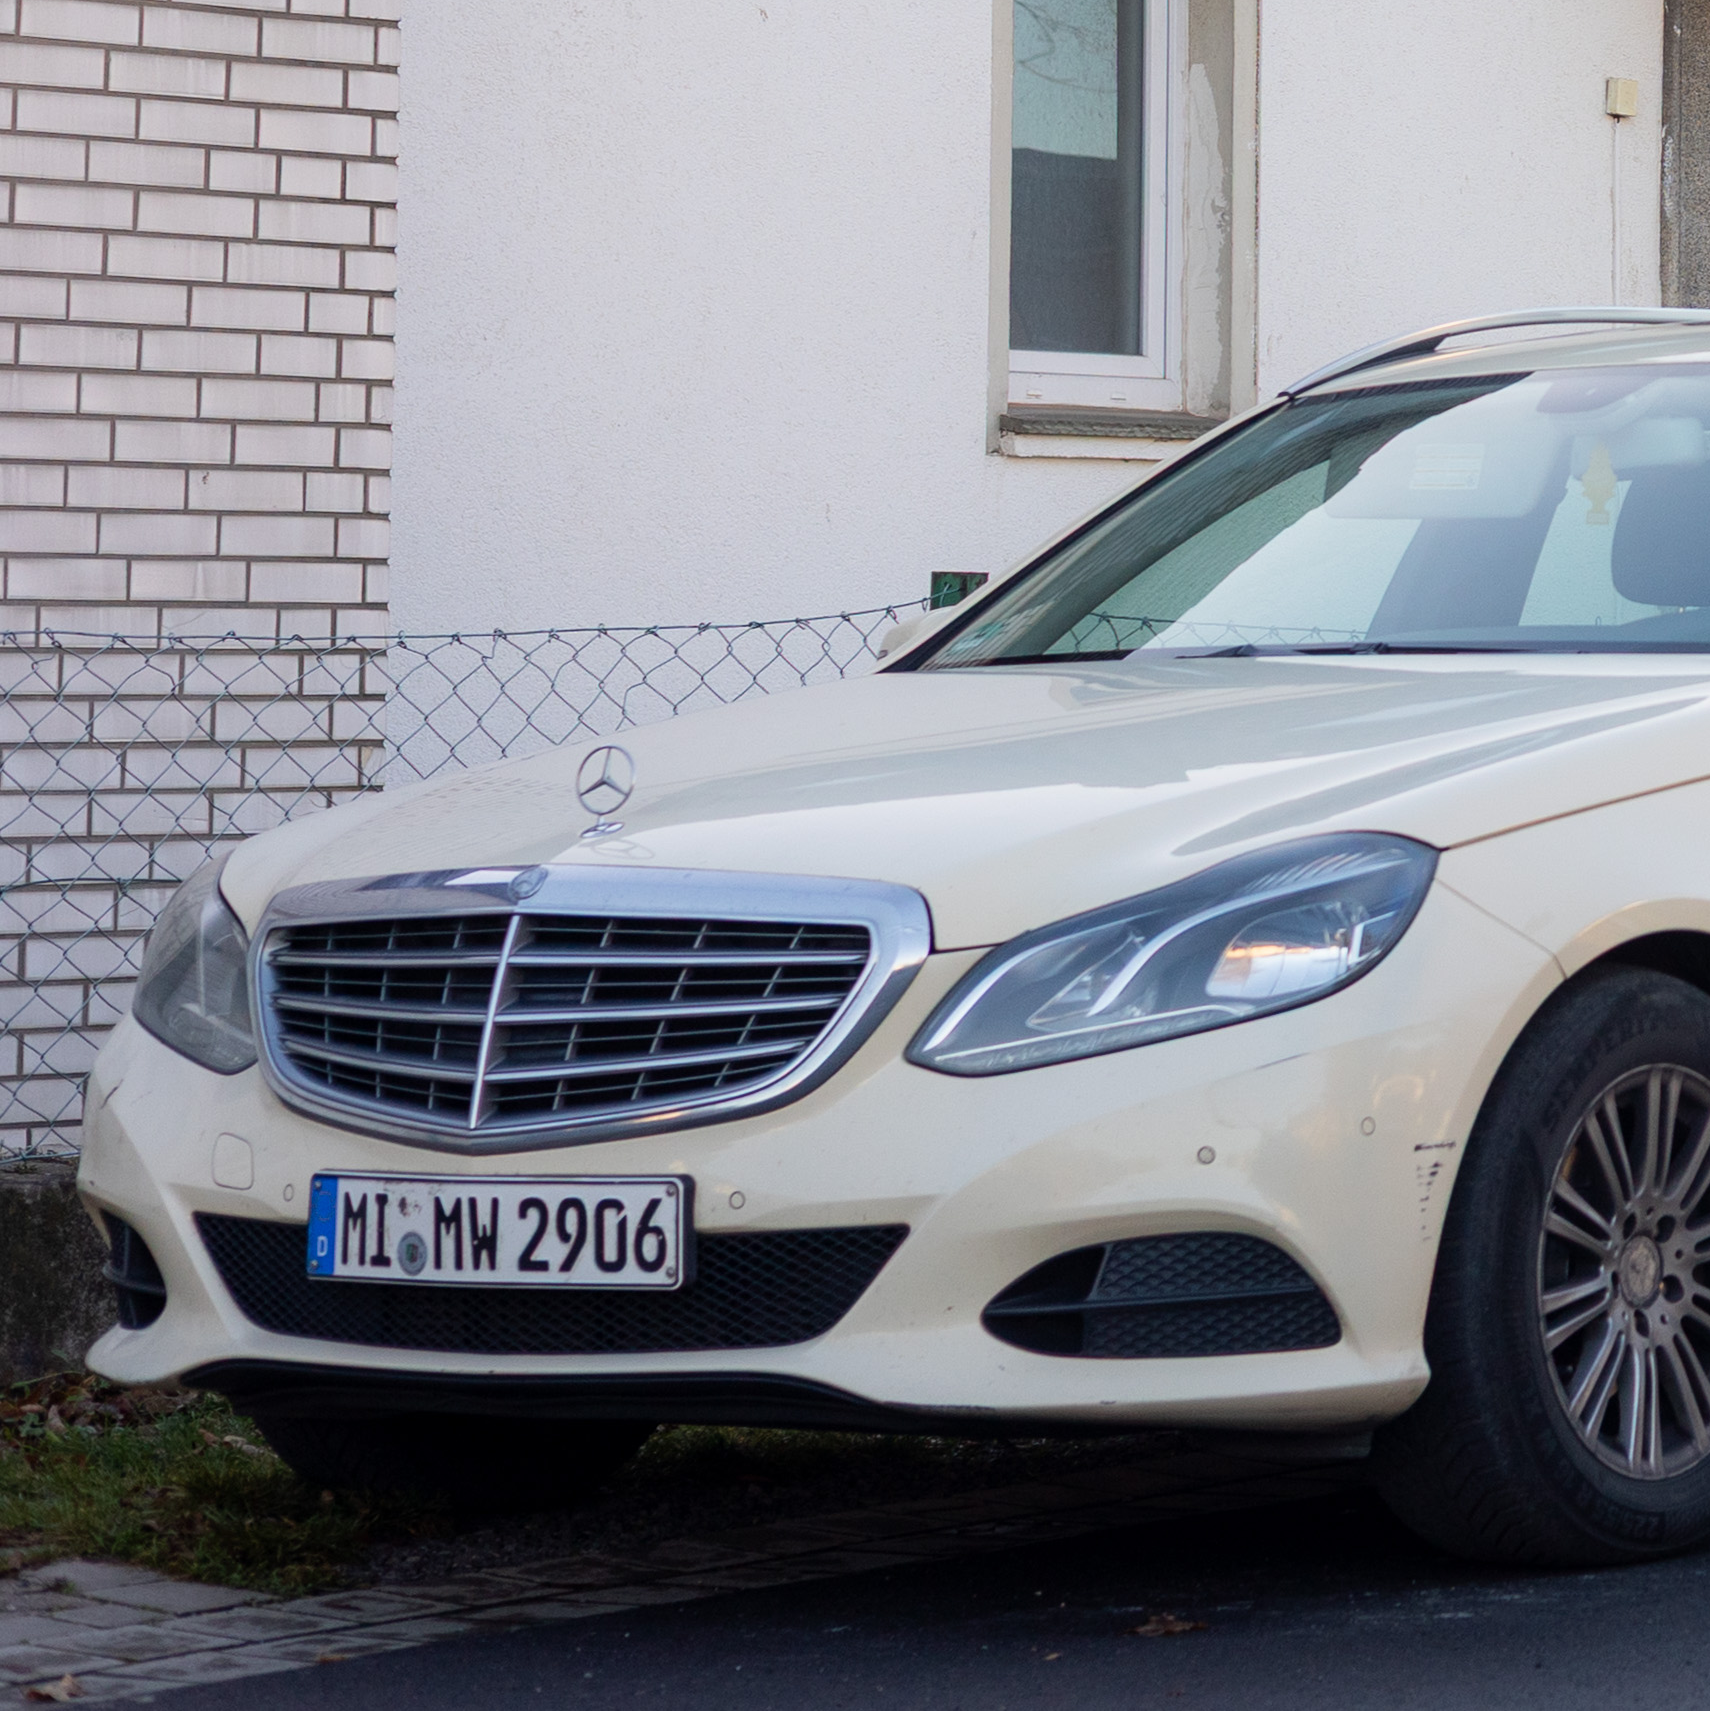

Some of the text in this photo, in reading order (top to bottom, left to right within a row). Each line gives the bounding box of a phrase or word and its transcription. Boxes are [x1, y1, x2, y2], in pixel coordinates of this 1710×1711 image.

[316, 1235, 328, 1257] D
[341, 1191, 668, 1274] MI MW 2906
